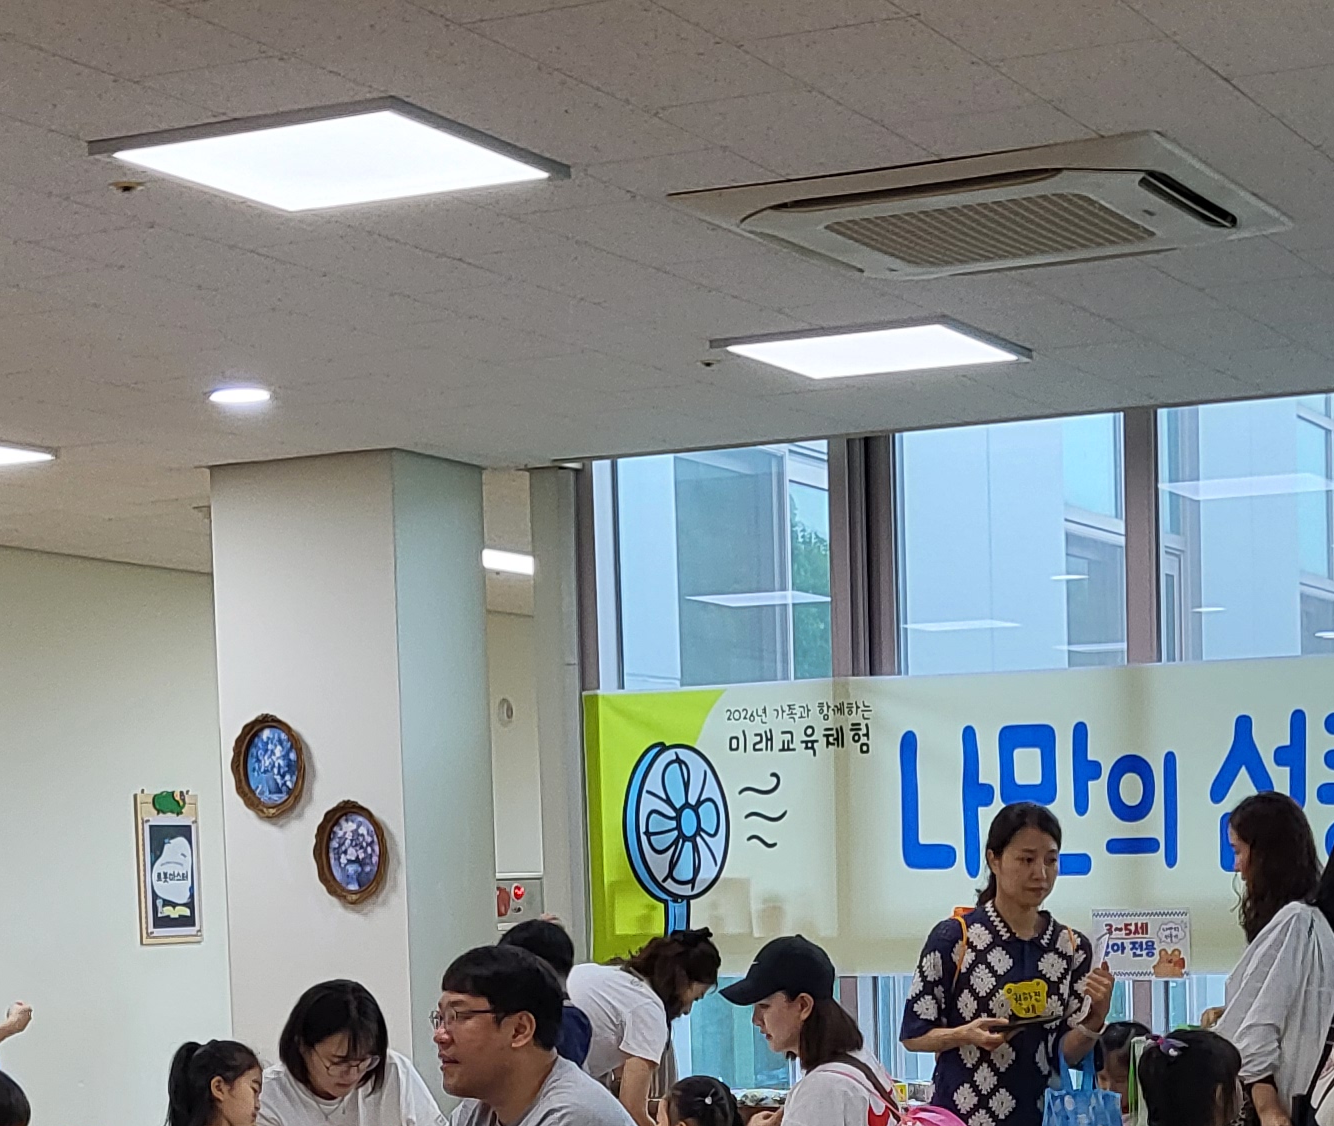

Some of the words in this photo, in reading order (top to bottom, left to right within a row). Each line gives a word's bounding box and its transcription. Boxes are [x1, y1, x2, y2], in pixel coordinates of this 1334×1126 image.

[725, 705, 768, 724] 2026년
[772, 703, 812, 723] 가족과
[817, 700, 873, 721] 함께하는
[728, 722, 871, 757] 미래교육체험
[899, 720, 1178, 878] 나만의
[1129, 940, 1157, 958] 전용
